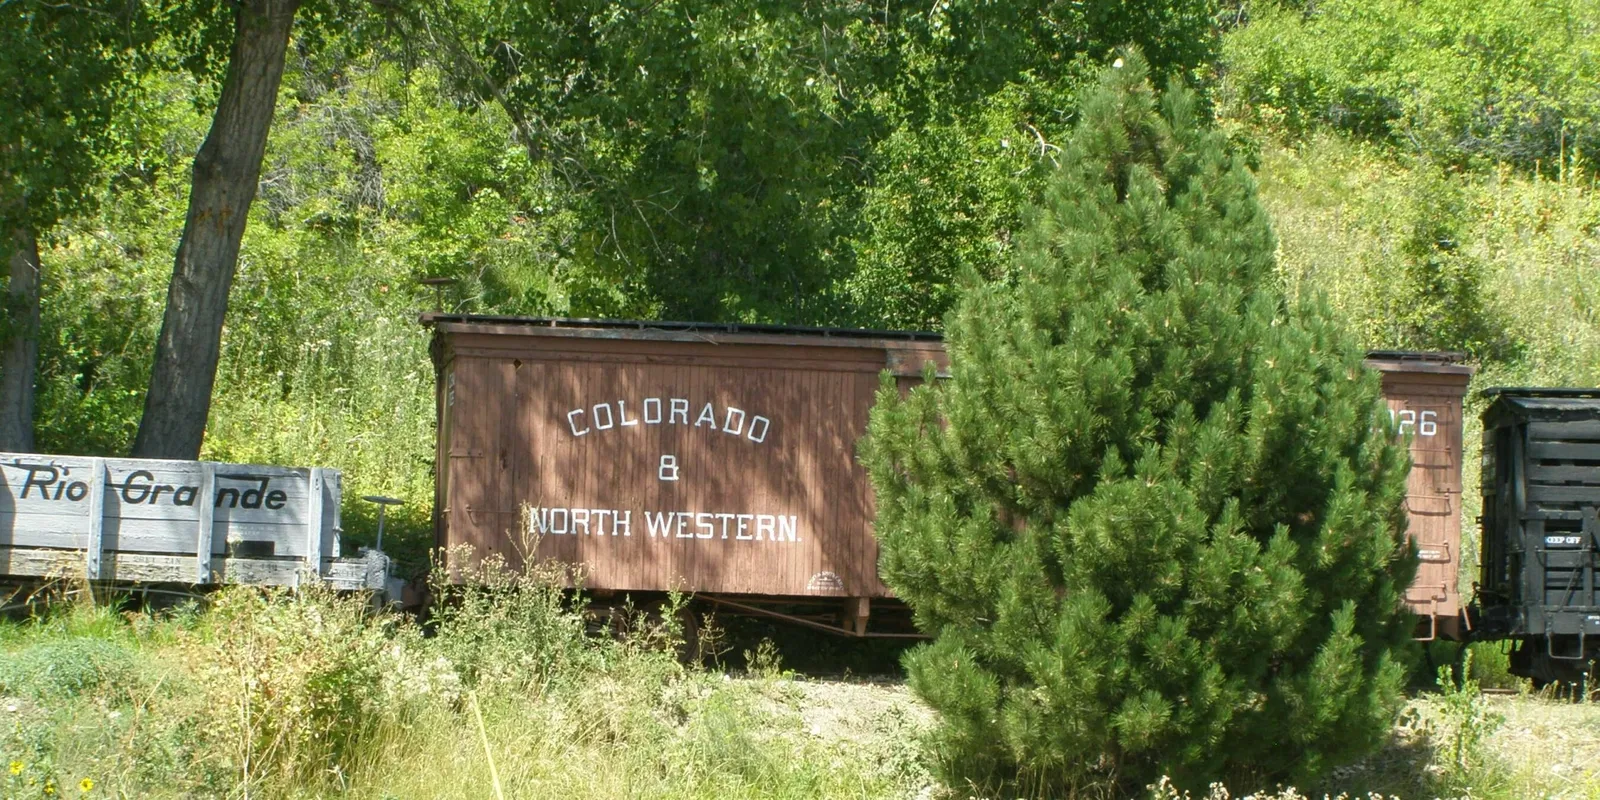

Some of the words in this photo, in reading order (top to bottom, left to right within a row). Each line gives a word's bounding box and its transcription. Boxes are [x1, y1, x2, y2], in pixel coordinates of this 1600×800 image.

[567, 397, 771, 444] COLORADO
[1369, 408, 1437, 436] 26
[658, 455, 680, 481] &
[8, 461, 89, 502] Rio
[104, 469, 287, 510] Grande
[528, 507, 632, 536] NORTH
[644, 511, 802, 542] WESTERN.
[1545, 536, 1565, 544] KEEP
[1566, 536, 1582, 544] OFF
